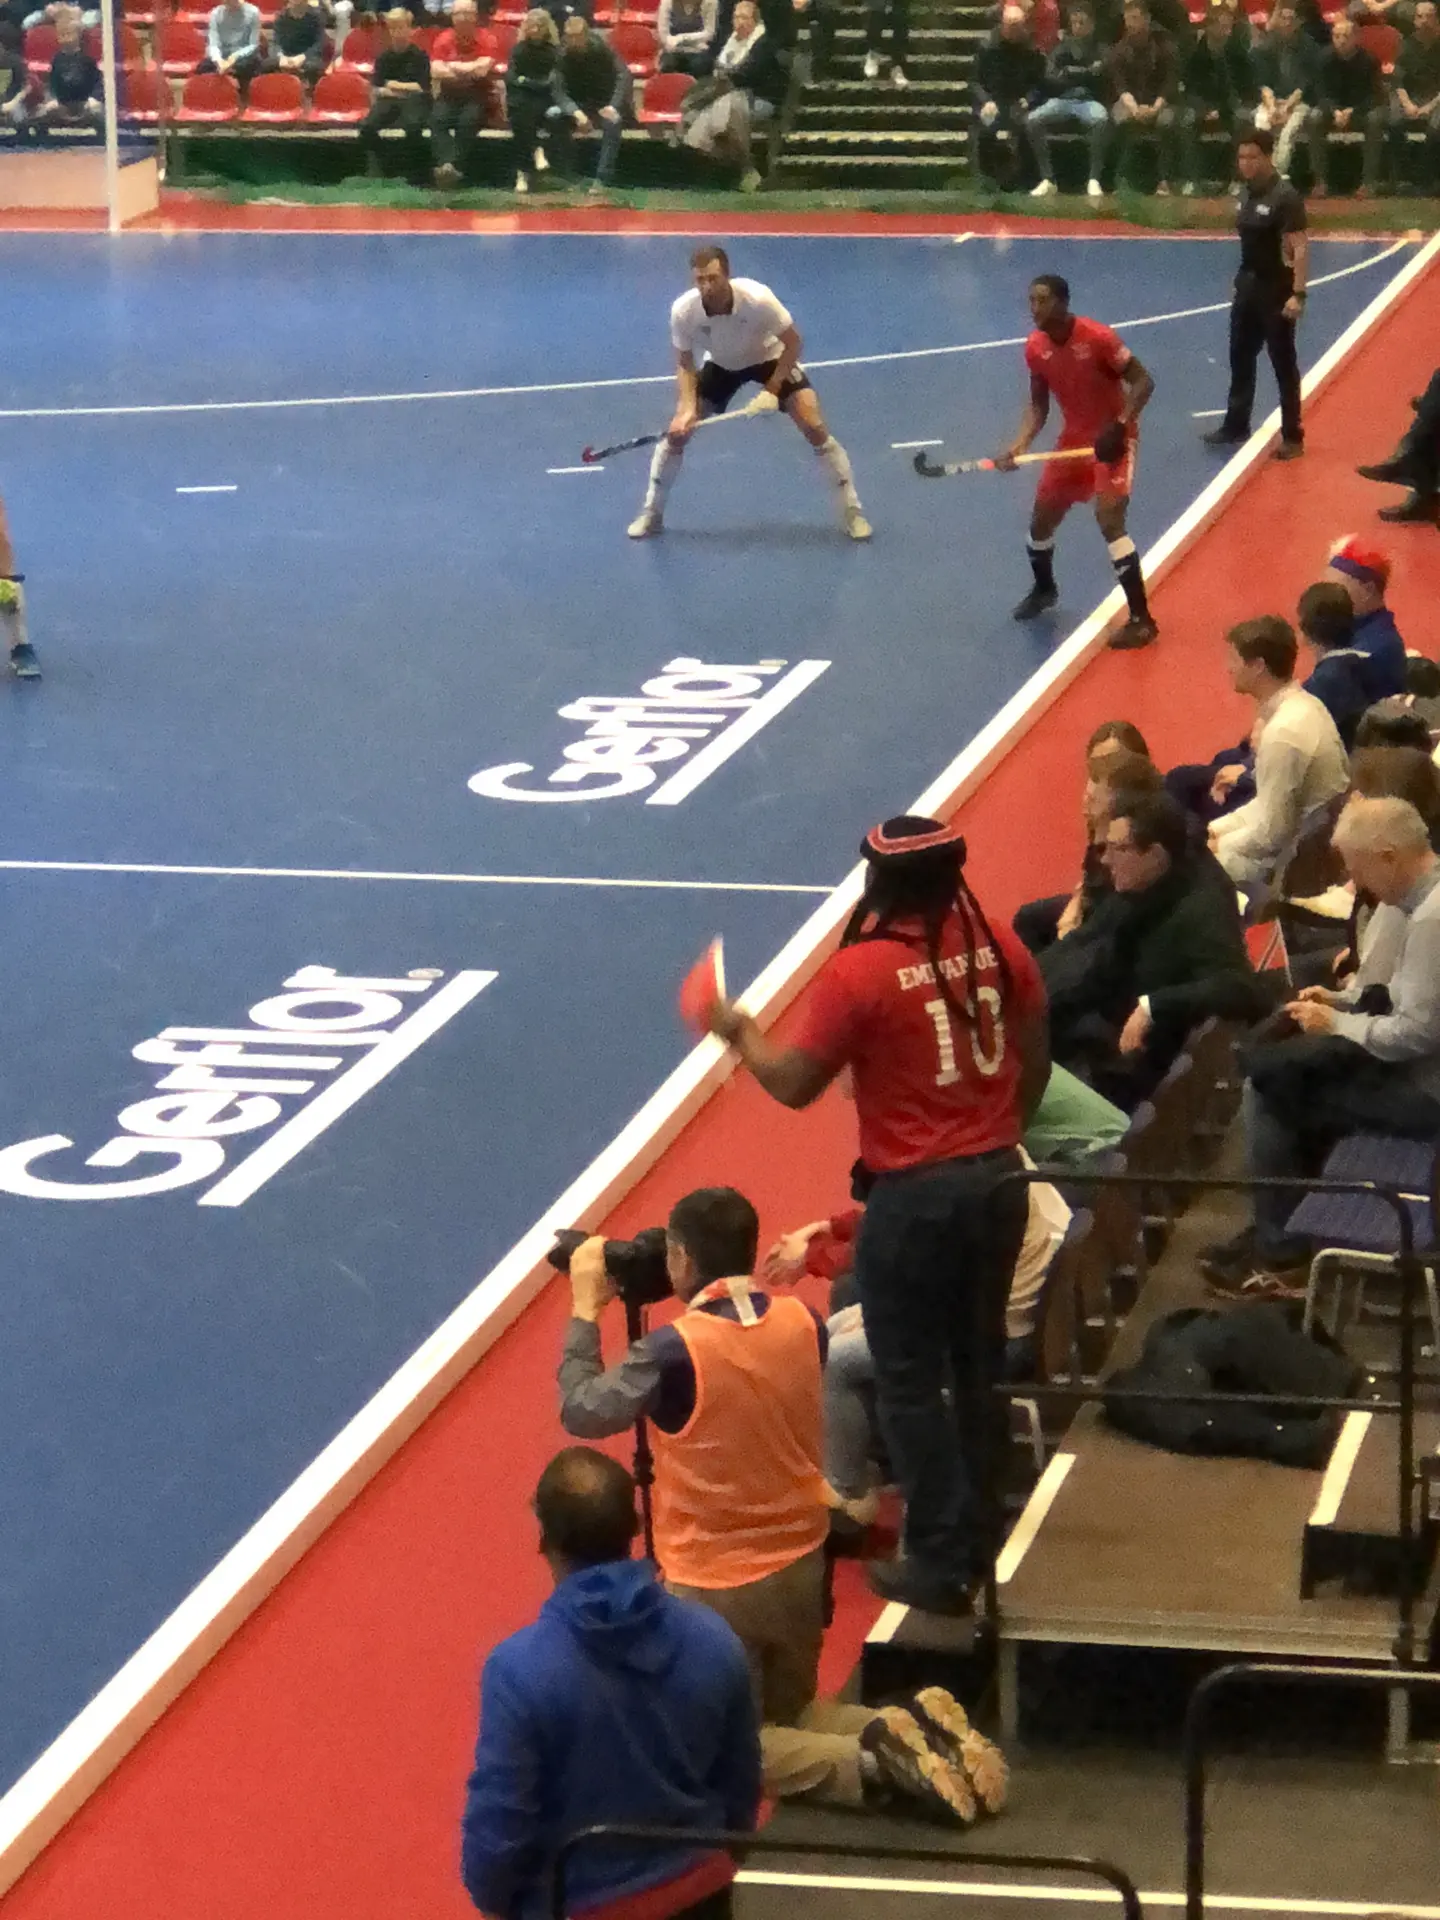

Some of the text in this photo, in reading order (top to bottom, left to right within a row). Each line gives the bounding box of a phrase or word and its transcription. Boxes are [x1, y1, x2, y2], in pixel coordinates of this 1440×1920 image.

[467, 656, 787, 802] Gerflor
[0, 965, 434, 1200] Gerflor
[924, 986, 1005, 1087] 10
